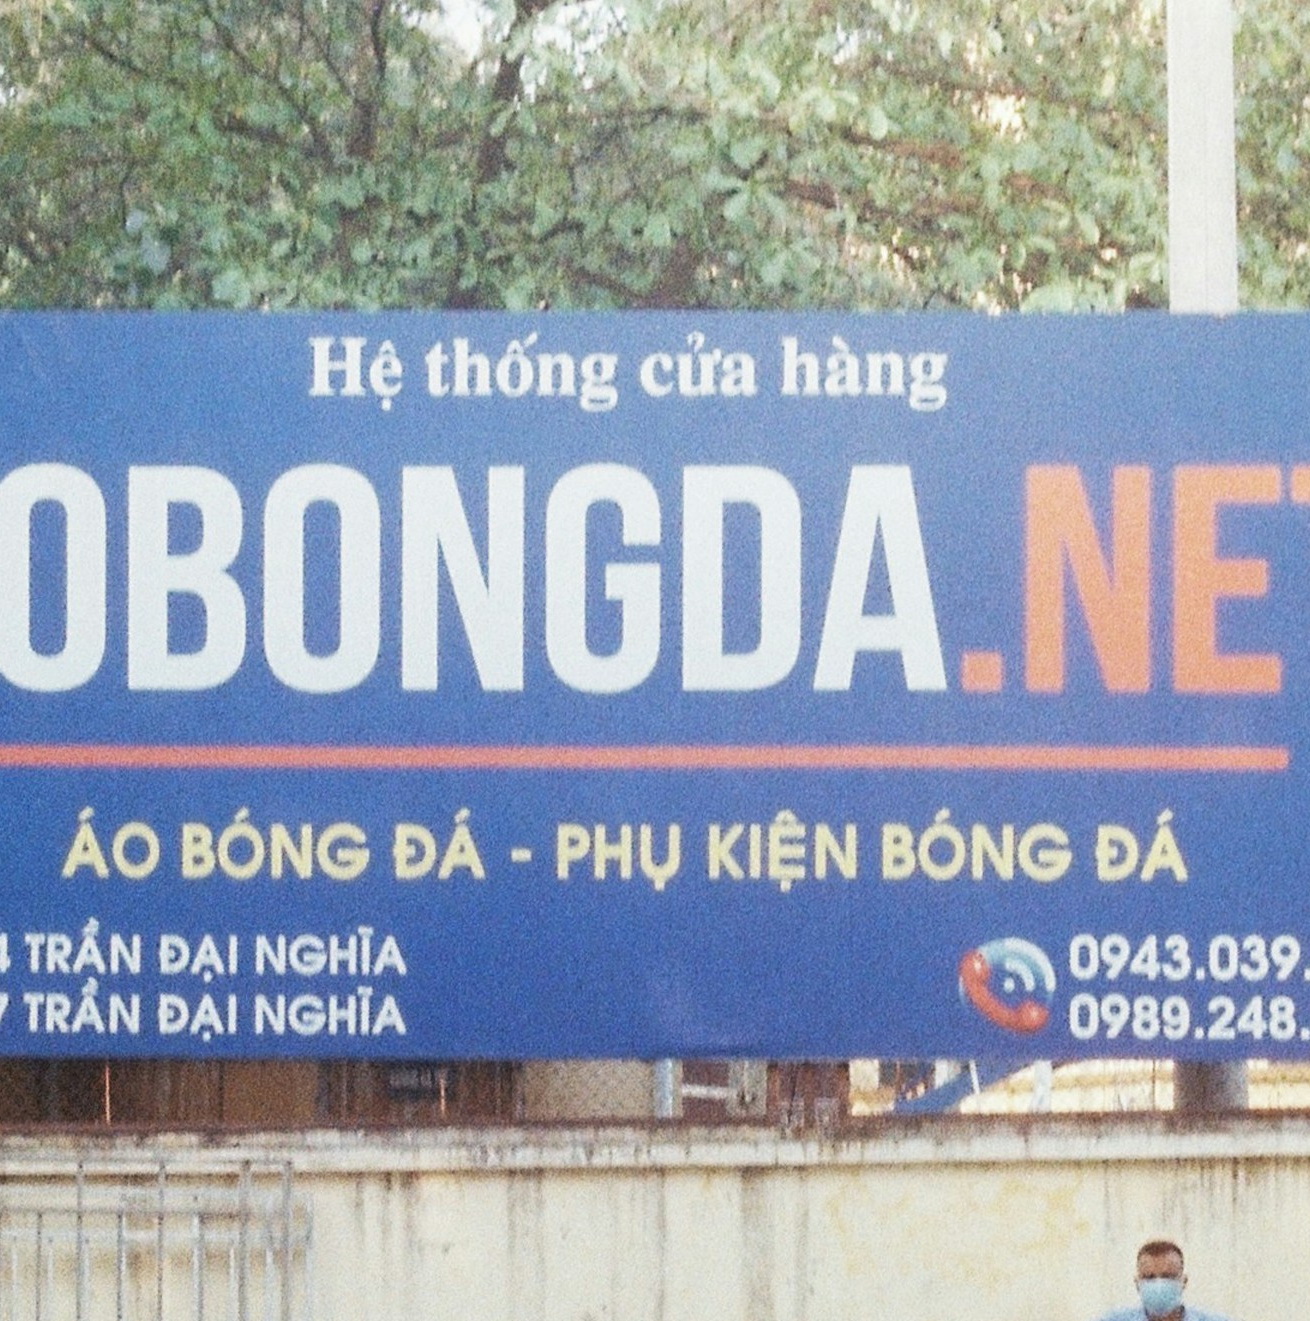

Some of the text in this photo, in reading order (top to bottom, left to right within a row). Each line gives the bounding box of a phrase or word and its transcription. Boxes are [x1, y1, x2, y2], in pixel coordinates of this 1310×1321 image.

[309, 331, 948, 412] Hệ thống cửa hàng
[61, 807, 160, 880] ÁO
[181, 807, 370, 881] BÓNG
[392, 807, 485, 880] ĐÁ
[556, 823, 681, 891] PHỤ
[707, 809, 858, 892] KIỆN
[881, 807, 1073, 883] BÓNG
[1094, 808, 1189, 882] ĐÁ
[24, 917, 142, 974] TRẦN
[158, 934, 238, 983] ĐẠI
[255, 926, 407, 975] NGHĨA
[23, 977, 141, 1034] TRẦN
[157, 992, 238, 1042] ĐẠI
[254, 986, 407, 1035] NGHĨA
